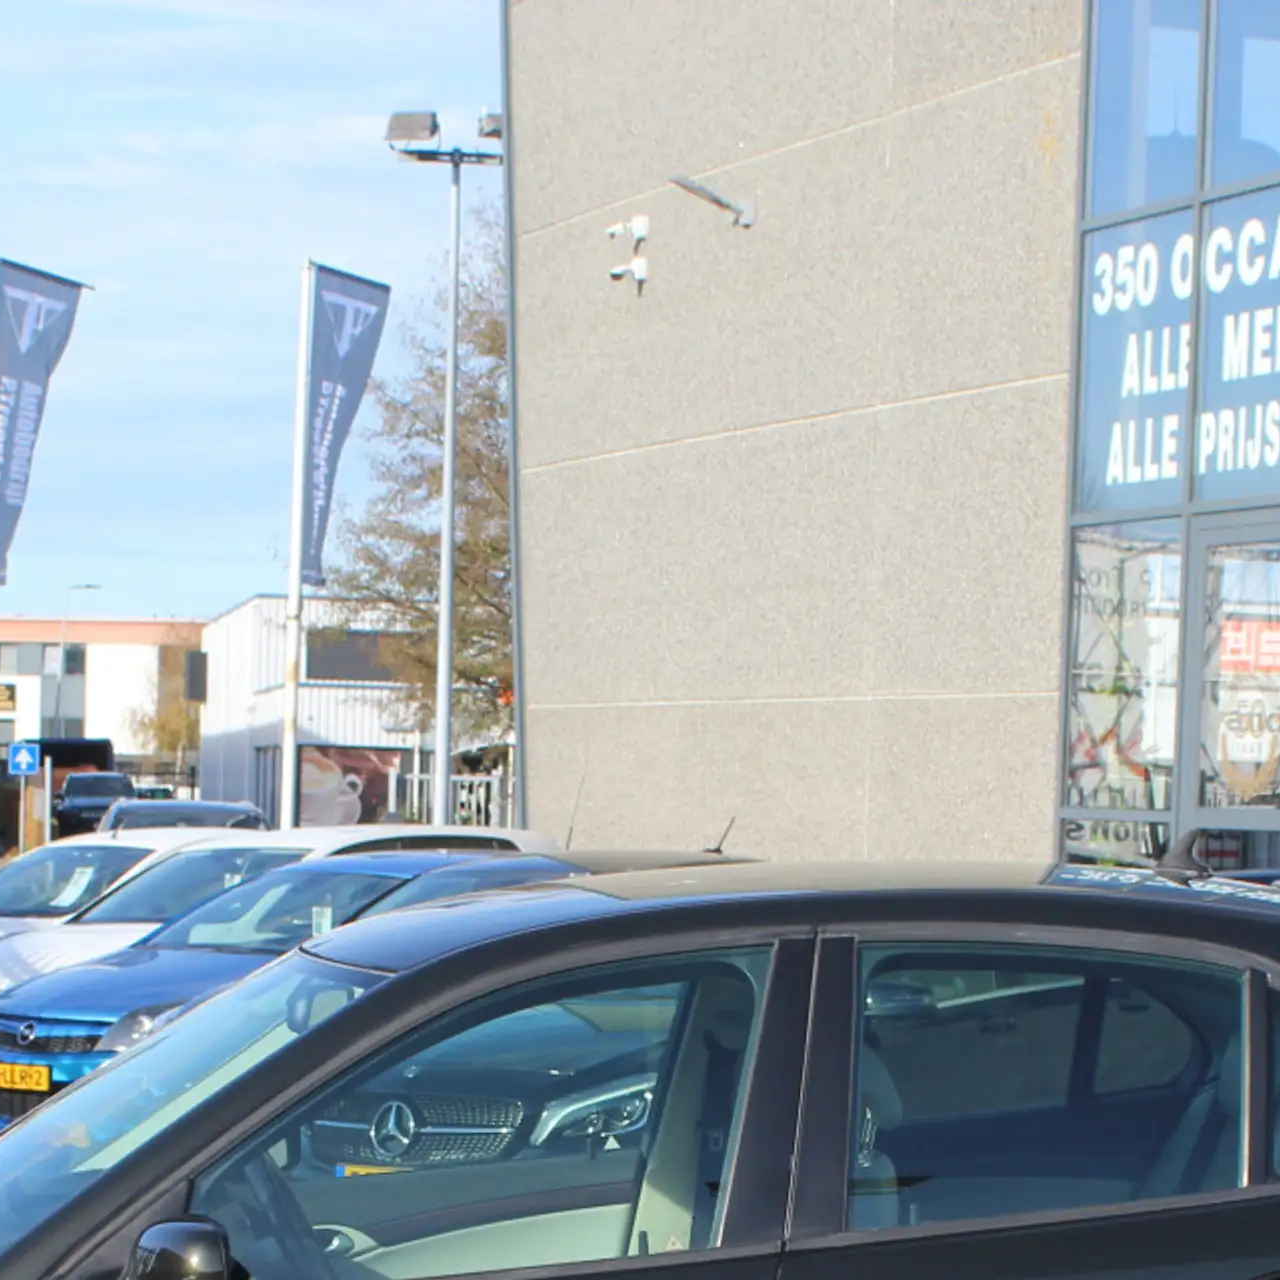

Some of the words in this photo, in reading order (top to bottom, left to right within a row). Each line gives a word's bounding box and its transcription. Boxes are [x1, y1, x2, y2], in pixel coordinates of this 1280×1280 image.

[1092, 242, 1159, 316] 350
[1120, 321, 1193, 399] ALLE
[1105, 413, 1180, 486] ALLE
